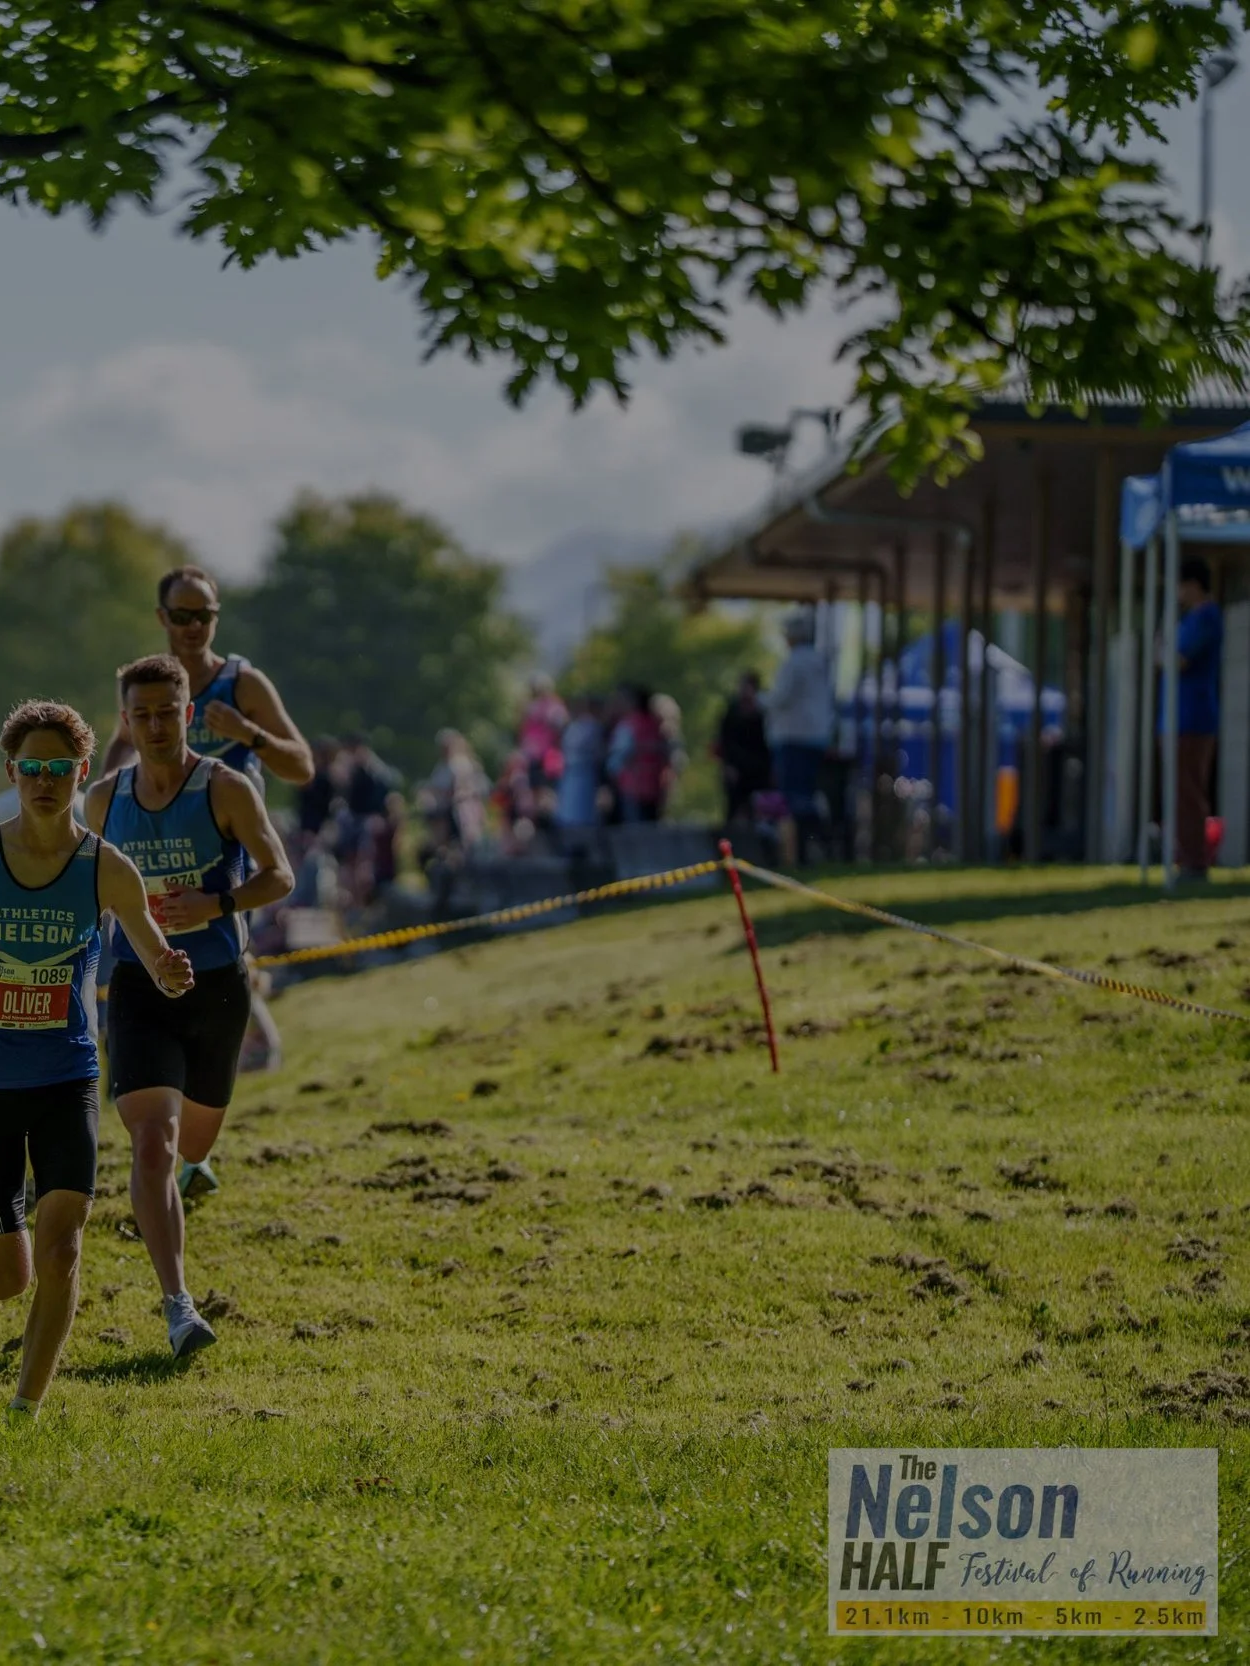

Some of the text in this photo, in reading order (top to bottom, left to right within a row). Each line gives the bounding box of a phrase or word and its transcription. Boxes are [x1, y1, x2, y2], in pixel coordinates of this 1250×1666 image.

[122, 838, 192, 852] ATHLETICS
[128, 851, 197, 871] ELSON
[31, 968, 68, 985] 1089
[3, 990, 52, 1014] OLIVER
